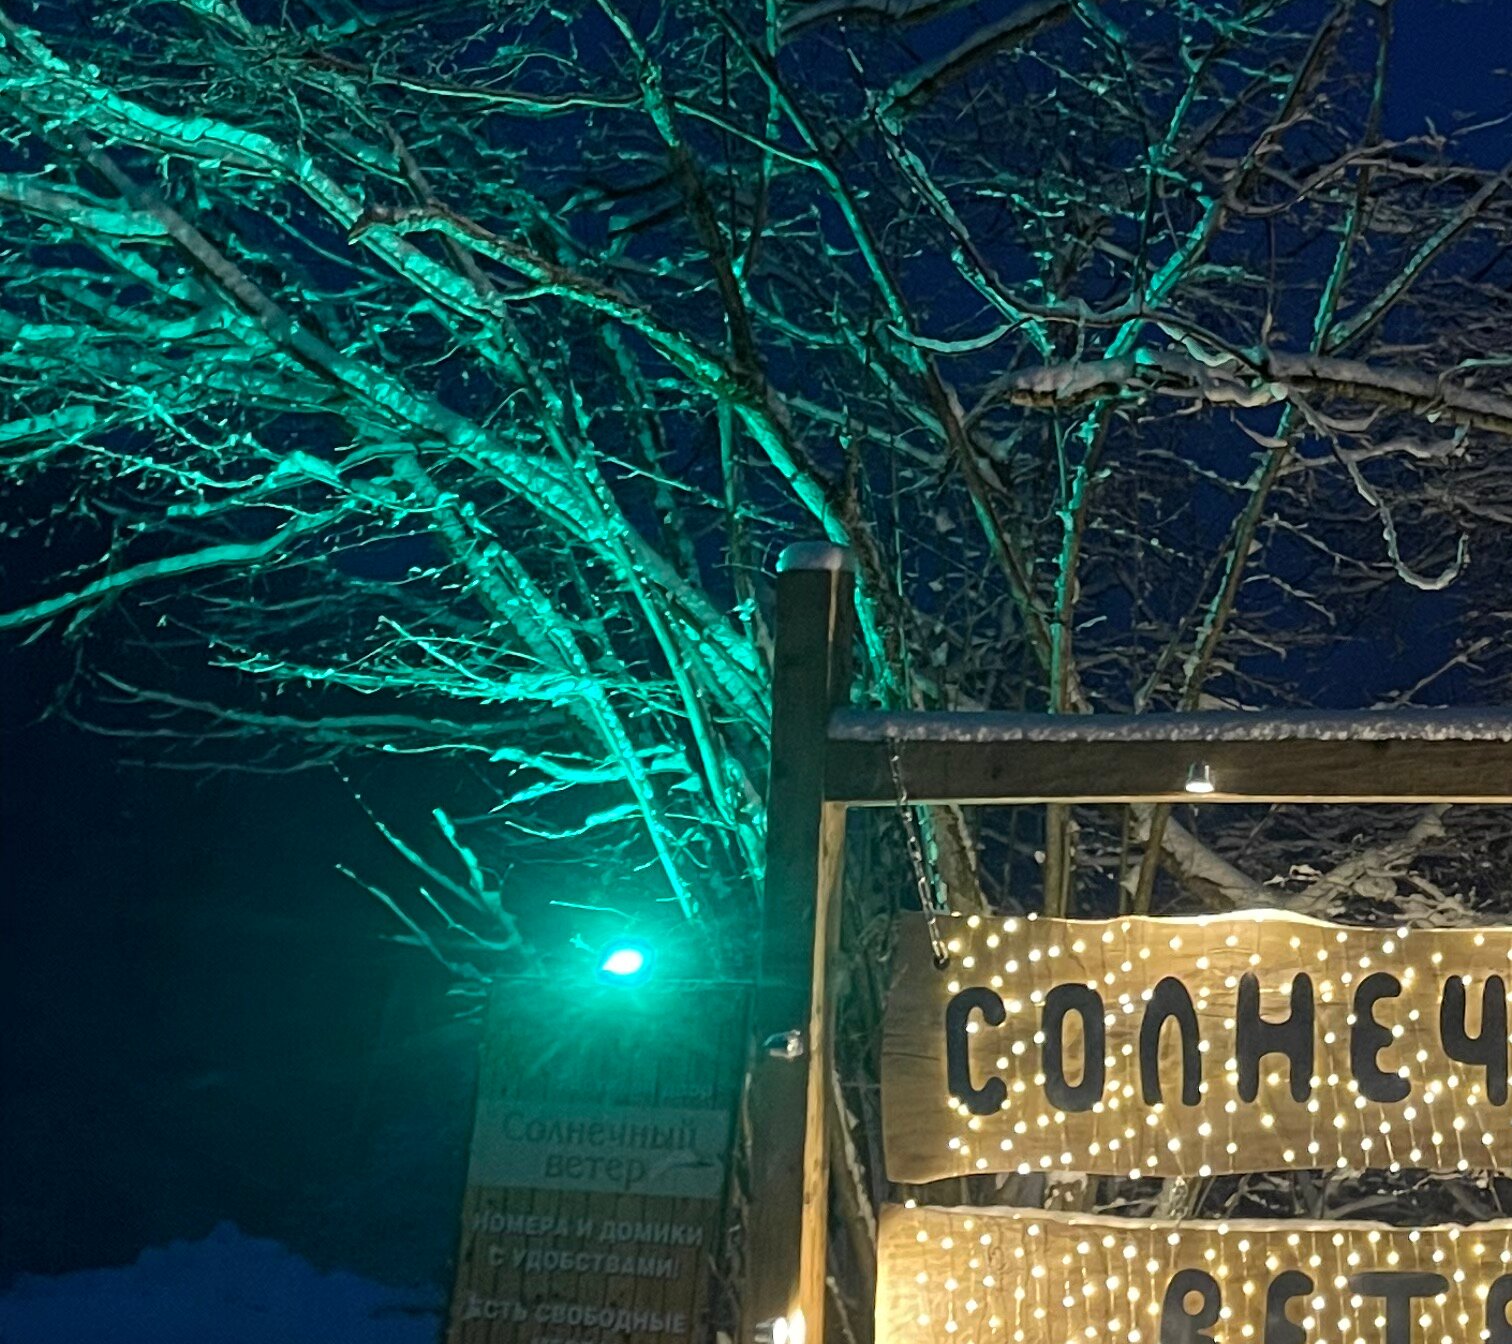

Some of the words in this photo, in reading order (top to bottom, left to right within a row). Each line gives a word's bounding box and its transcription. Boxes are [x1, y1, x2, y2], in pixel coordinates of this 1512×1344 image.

[502, 1112, 698, 1151] Солнечный
[545, 1154, 647, 1190] ветер
[472, 1209, 568, 1236] НОМЕРА
[576, 1219, 593, 1238] И
[599, 1221, 703, 1246] ДОМИКИ
[487, 1243, 505, 1267] С
[511, 1247, 680, 1279] УДОБСТВАМИ!
[463, 1296, 528, 1321] ЕСТЬ
[535, 1302, 688, 1334] СВОБОДНЫЕ
